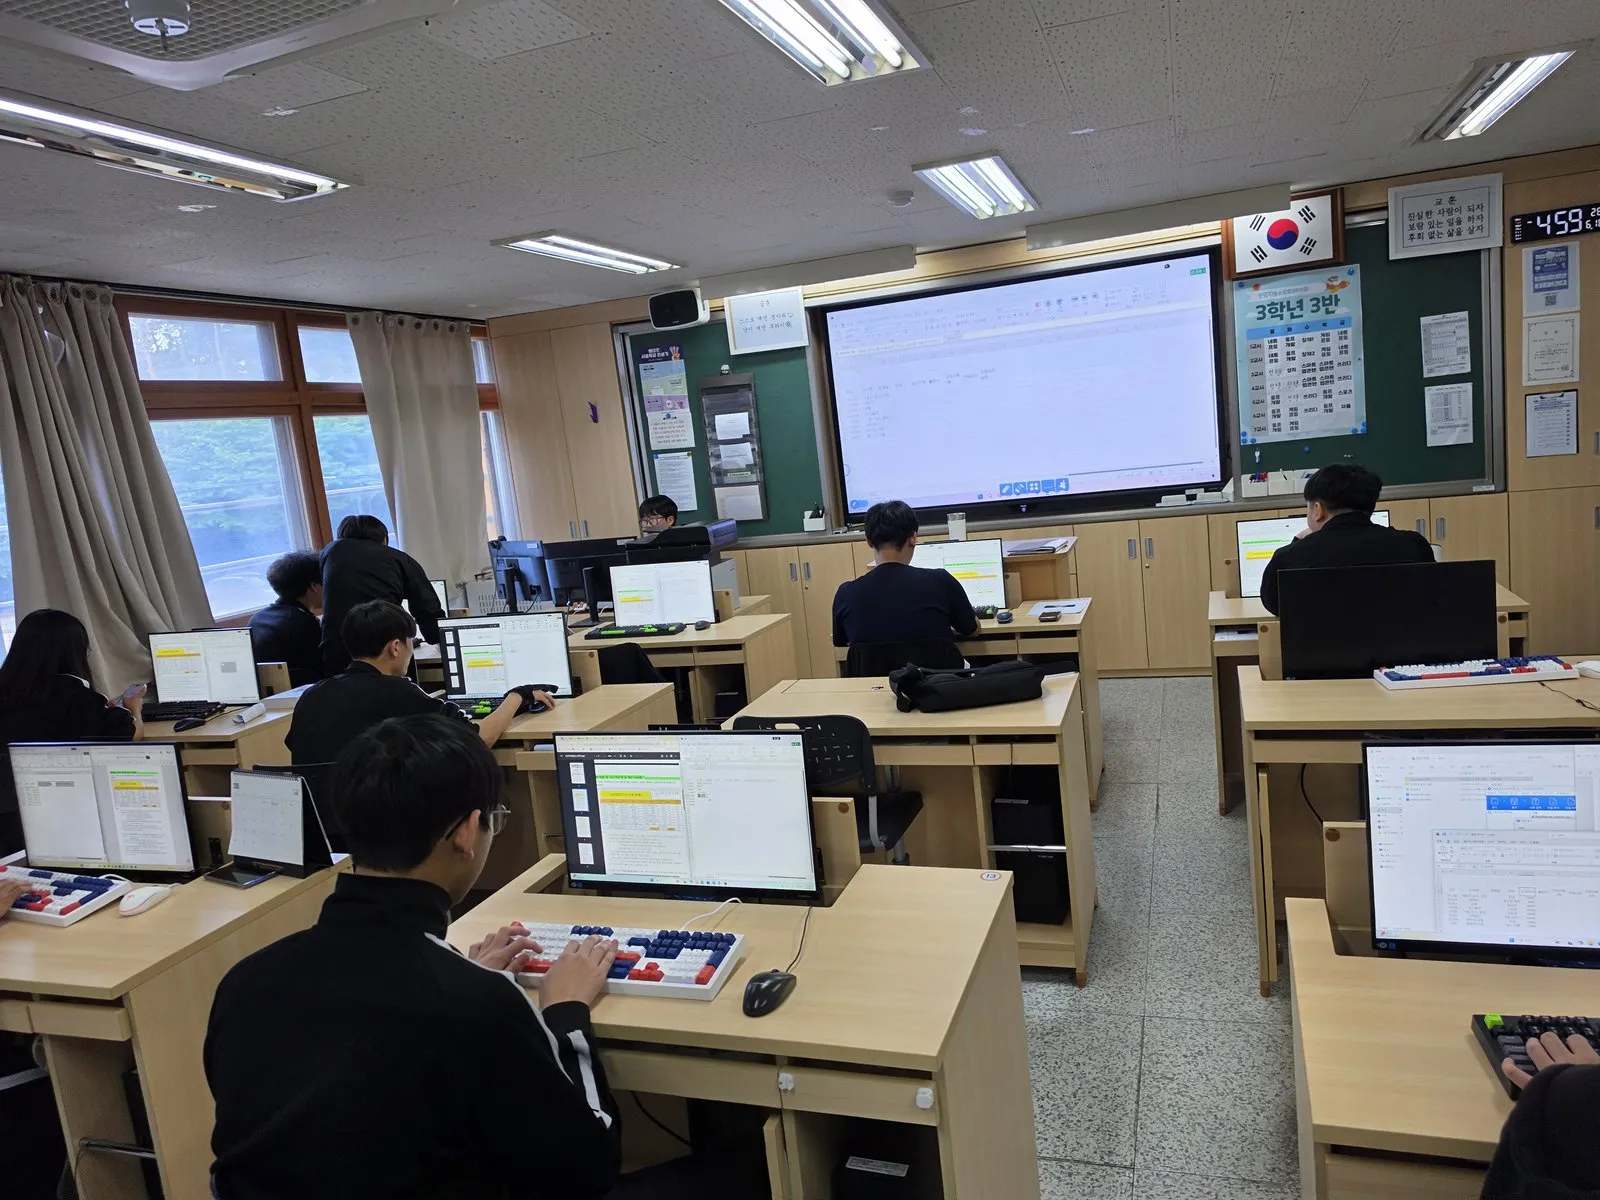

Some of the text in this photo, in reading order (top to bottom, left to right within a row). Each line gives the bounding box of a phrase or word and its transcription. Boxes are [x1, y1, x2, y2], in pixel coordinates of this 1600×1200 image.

[1408, 203, 1484, 221] 진실한 사람이 되자
[1408, 214, 1484, 231] 보람 있는 일을 하자
[1408, 226, 1484, 242] 후회 없는 삶을 살자
[1256, 294, 1340, 320] 3학년 3반
